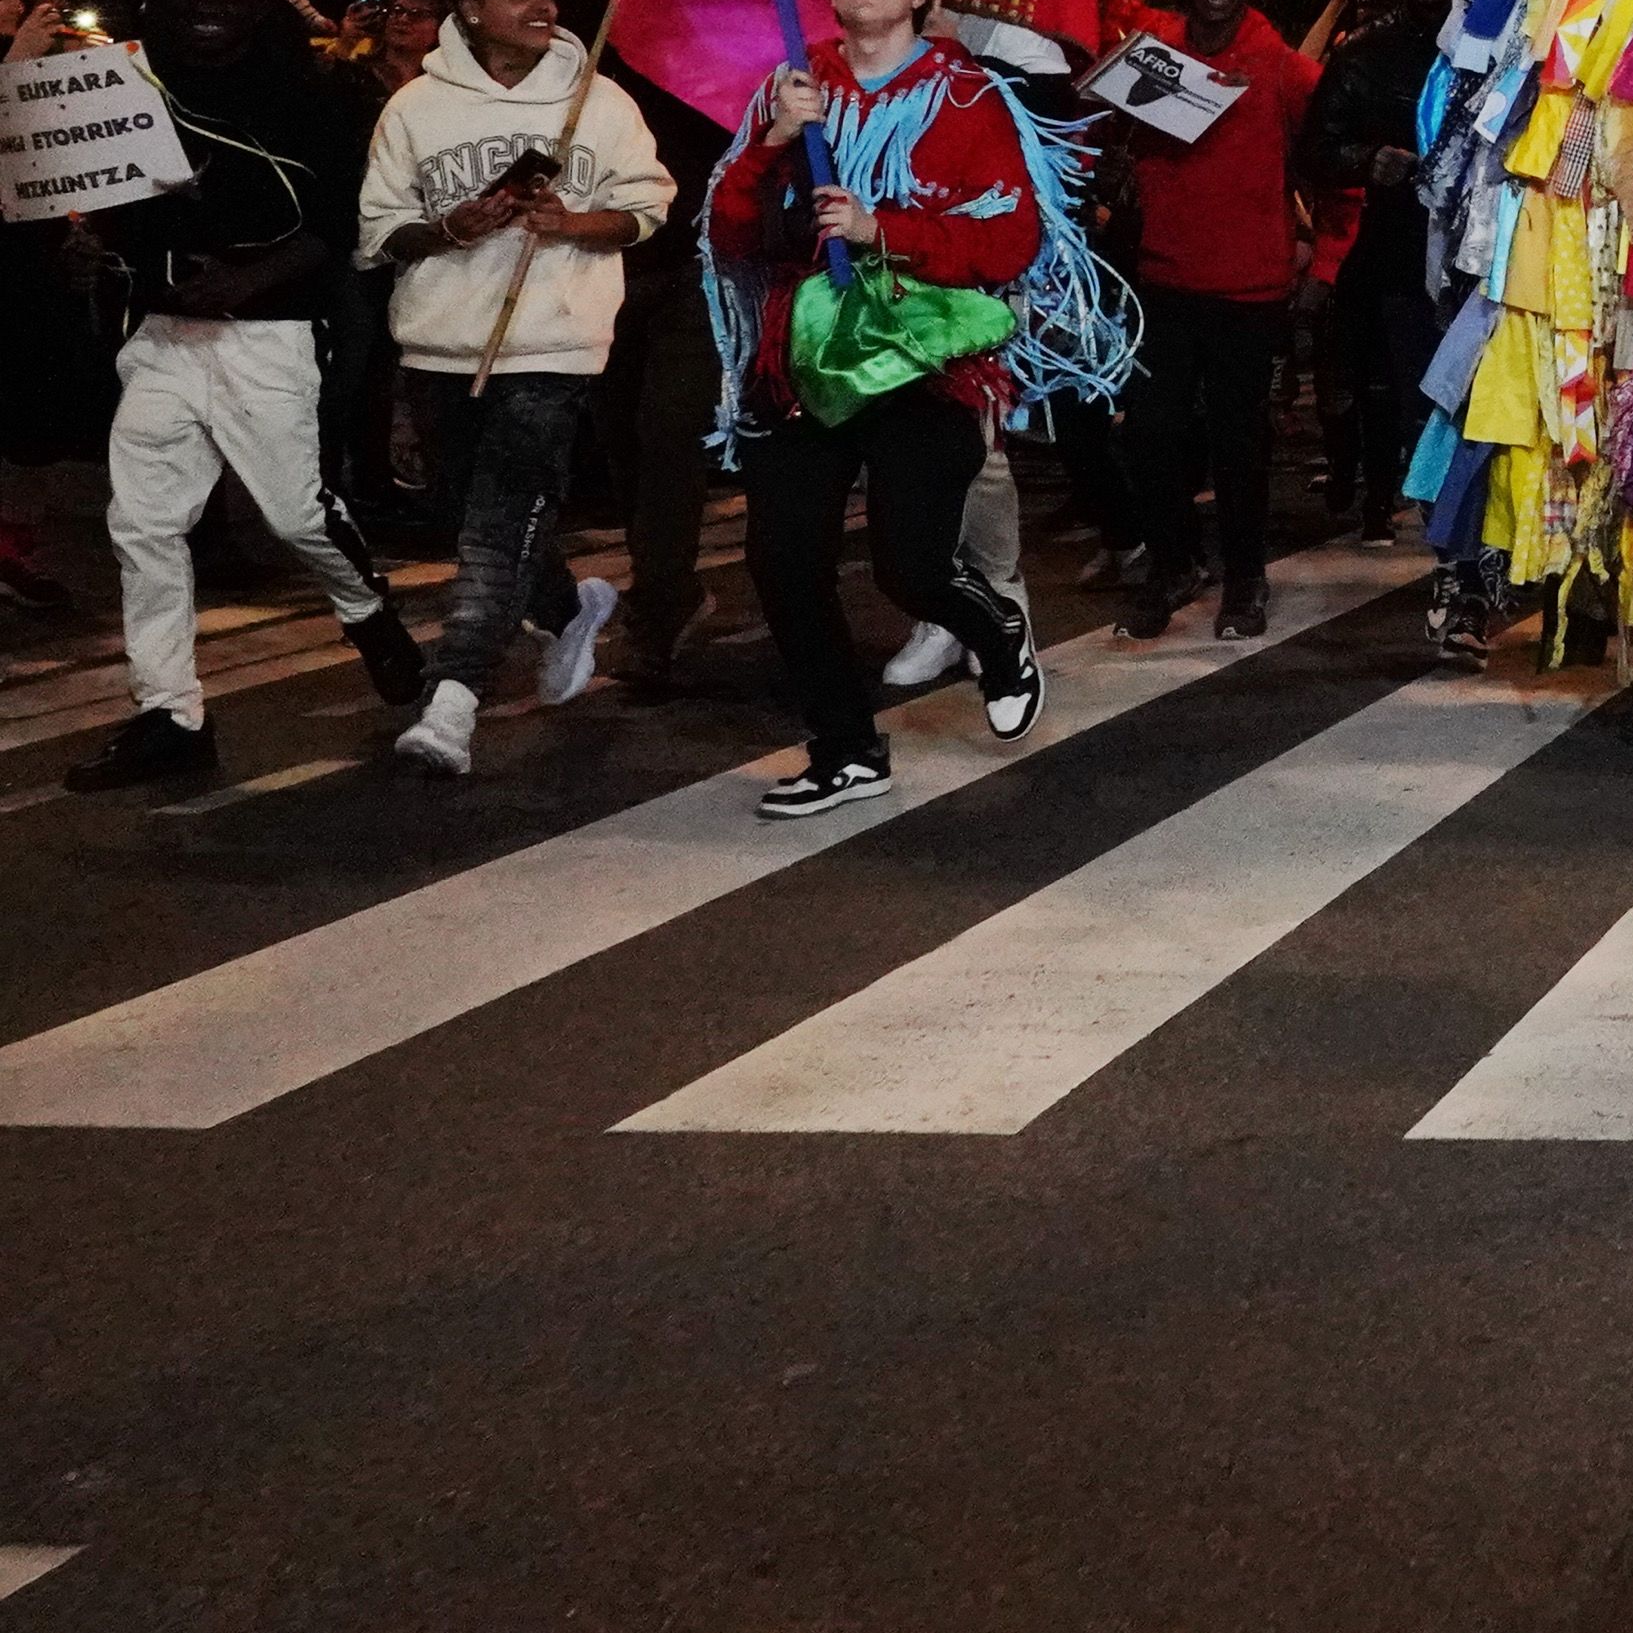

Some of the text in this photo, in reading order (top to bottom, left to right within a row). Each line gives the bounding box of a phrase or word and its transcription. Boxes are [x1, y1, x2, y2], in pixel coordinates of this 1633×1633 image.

[1130, 49, 1180, 79] AFRO
[17, 69, 125, 102] EUSKARA
[31, 112, 154, 150] ETORRIKO
